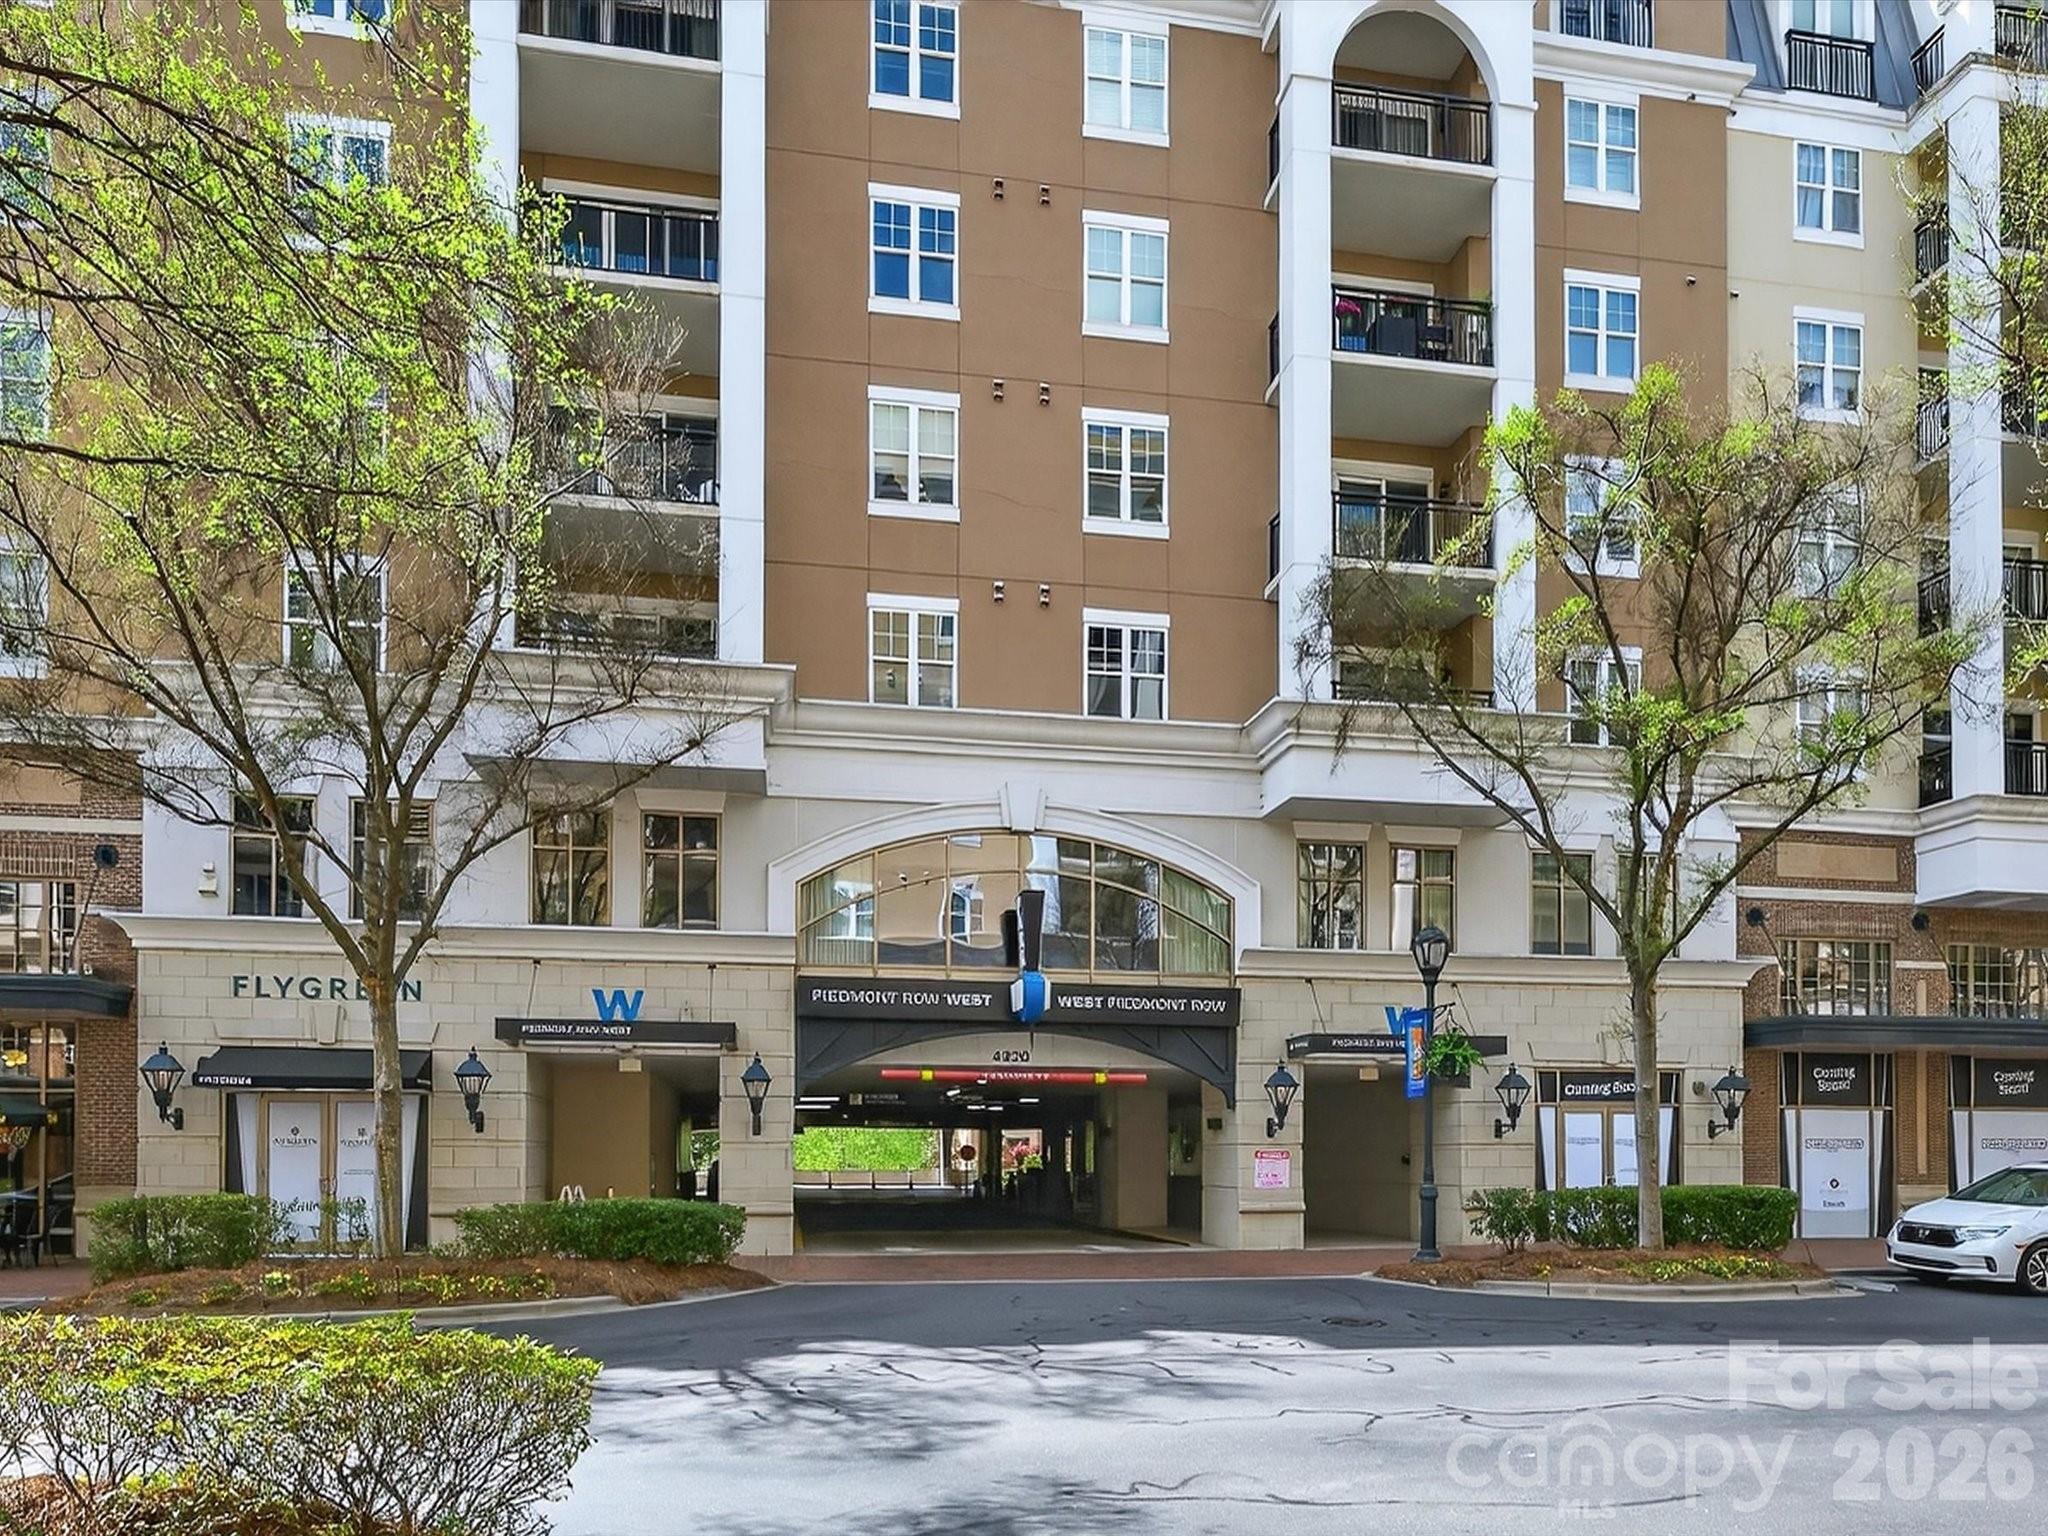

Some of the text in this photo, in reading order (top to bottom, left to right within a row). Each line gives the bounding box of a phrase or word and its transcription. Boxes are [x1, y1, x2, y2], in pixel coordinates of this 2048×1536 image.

[232, 975, 422, 1002] FLYGREN
[811, 989, 992, 1007] PIEDMONT ROW WEST
[591, 987, 645, 1021] W
[1057, 995, 1103, 1009] WEST
